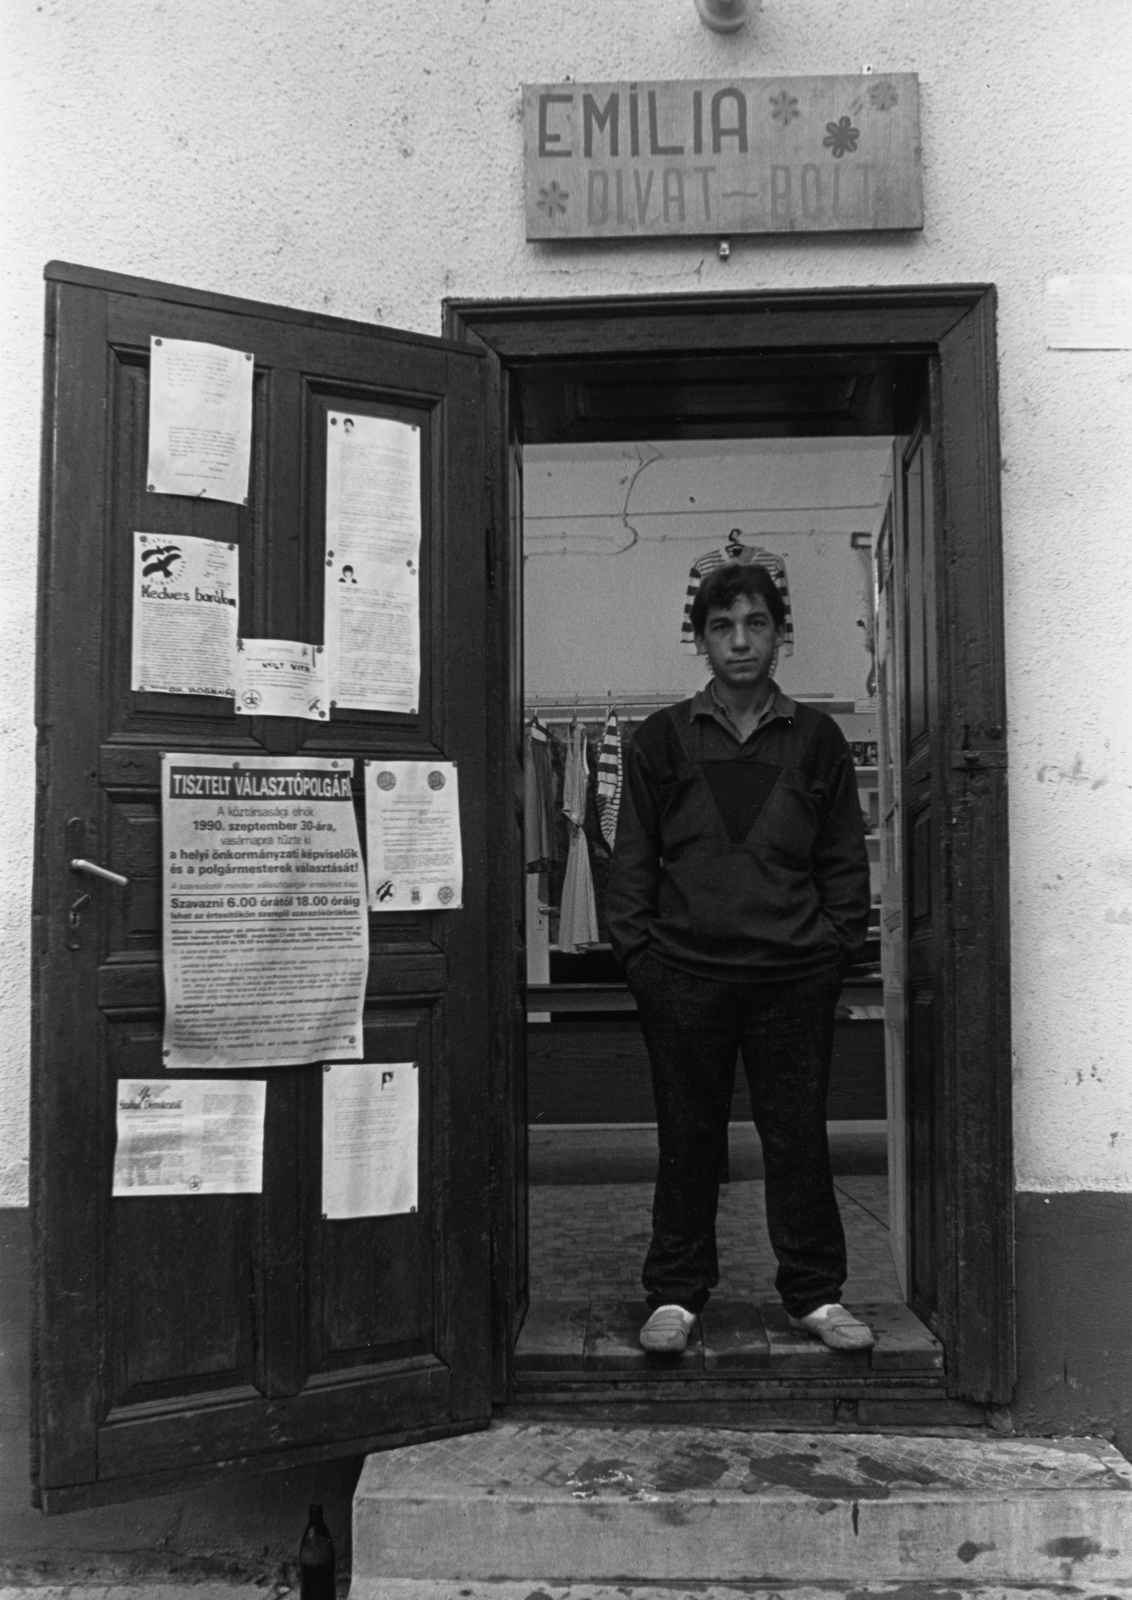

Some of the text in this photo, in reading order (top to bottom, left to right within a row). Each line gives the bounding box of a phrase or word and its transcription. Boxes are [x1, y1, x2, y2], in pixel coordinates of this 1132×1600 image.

[173, 774, 231, 796] TISZTELT
[216, 806, 315, 818] A köztársasági elnök
[193, 820, 337, 833] 1990. szeptember 30-ára,
[220, 835, 274, 847] vasárnapra
[277, 834, 302, 846] tűzte
[169, 848, 359, 862] a helyi önkormányzati képviselők
[170, 862, 359, 876] és a polgármesterek választását!
[170, 895, 360, 909] Szavazni 6.00 órától 18.00 óráig
[170, 911, 192, 920] lehet
[194, 912, 205, 920] az
